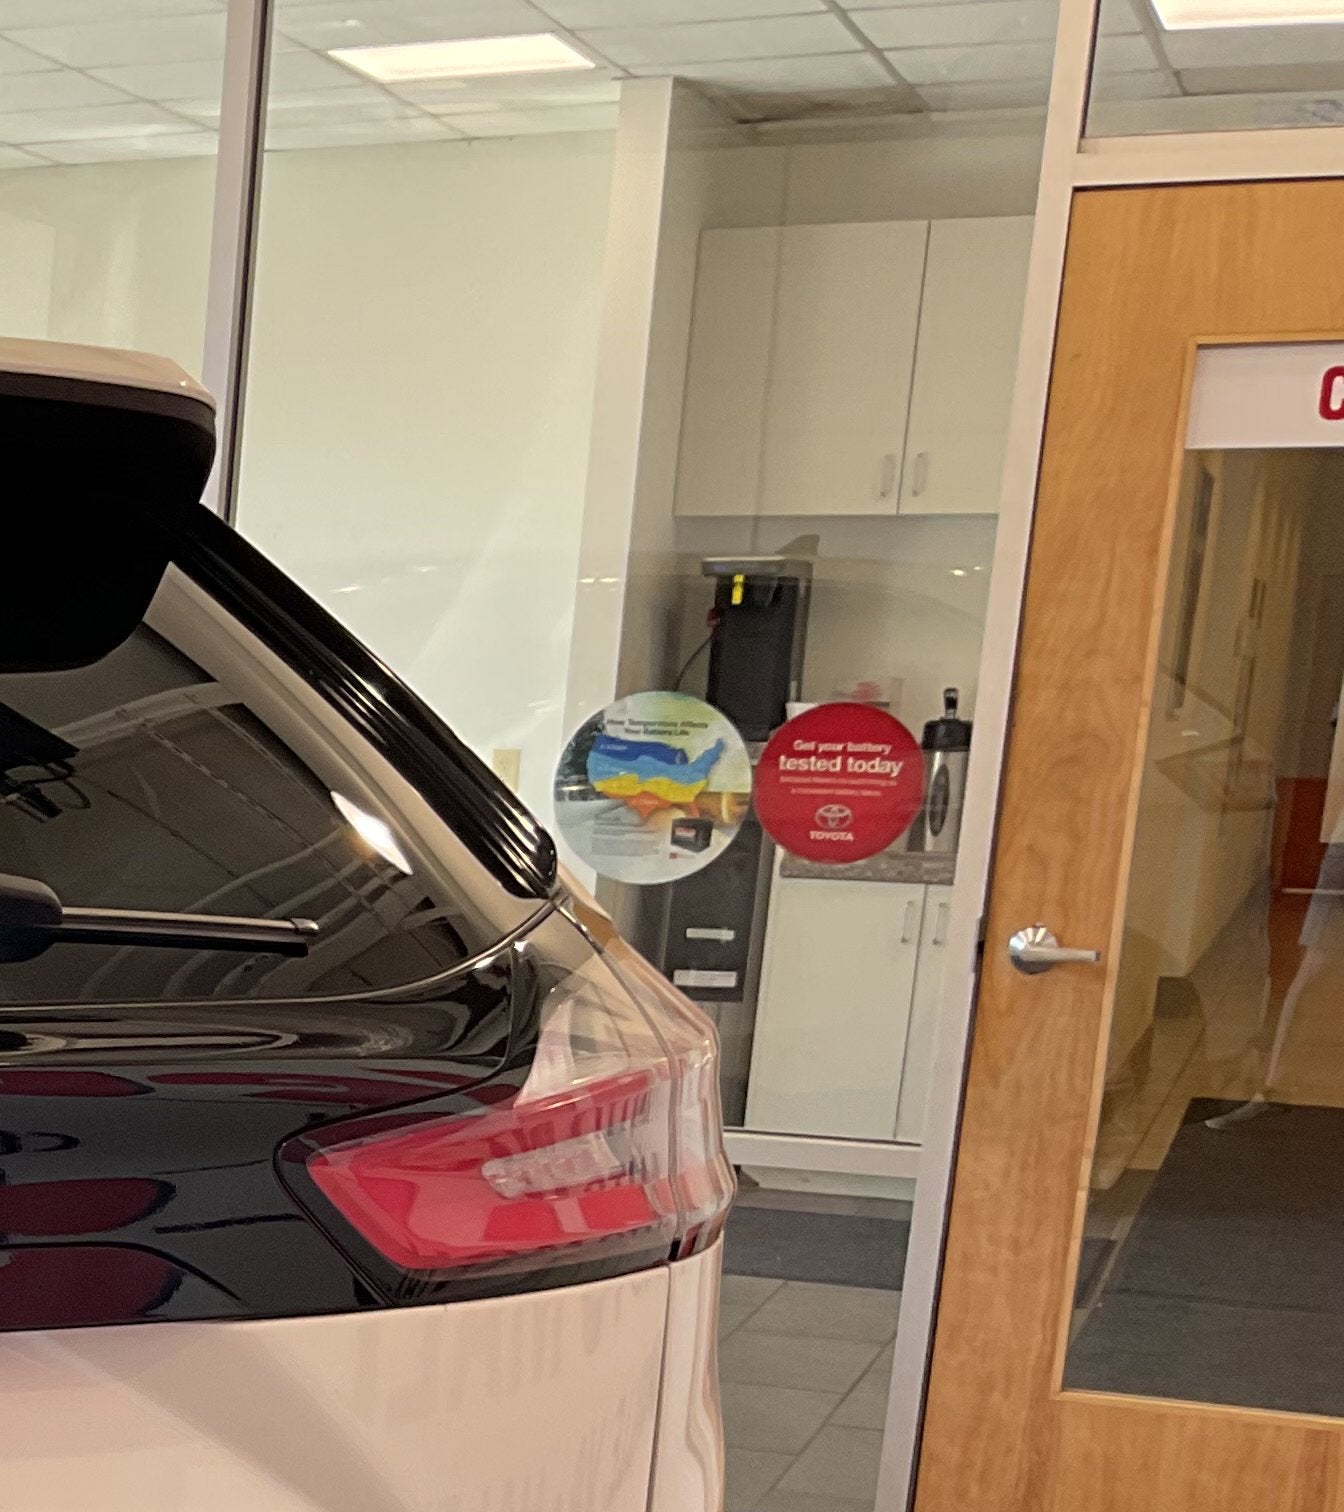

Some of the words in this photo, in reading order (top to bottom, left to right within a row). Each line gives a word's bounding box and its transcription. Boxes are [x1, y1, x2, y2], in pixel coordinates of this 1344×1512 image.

[793, 740, 816, 751] Get
[817, 743, 845, 754] your
[846, 742, 892, 755] battery
[779, 755, 842, 772] tested
[847, 757, 903, 777] today
[809, 830, 854, 841] TOYOTA
